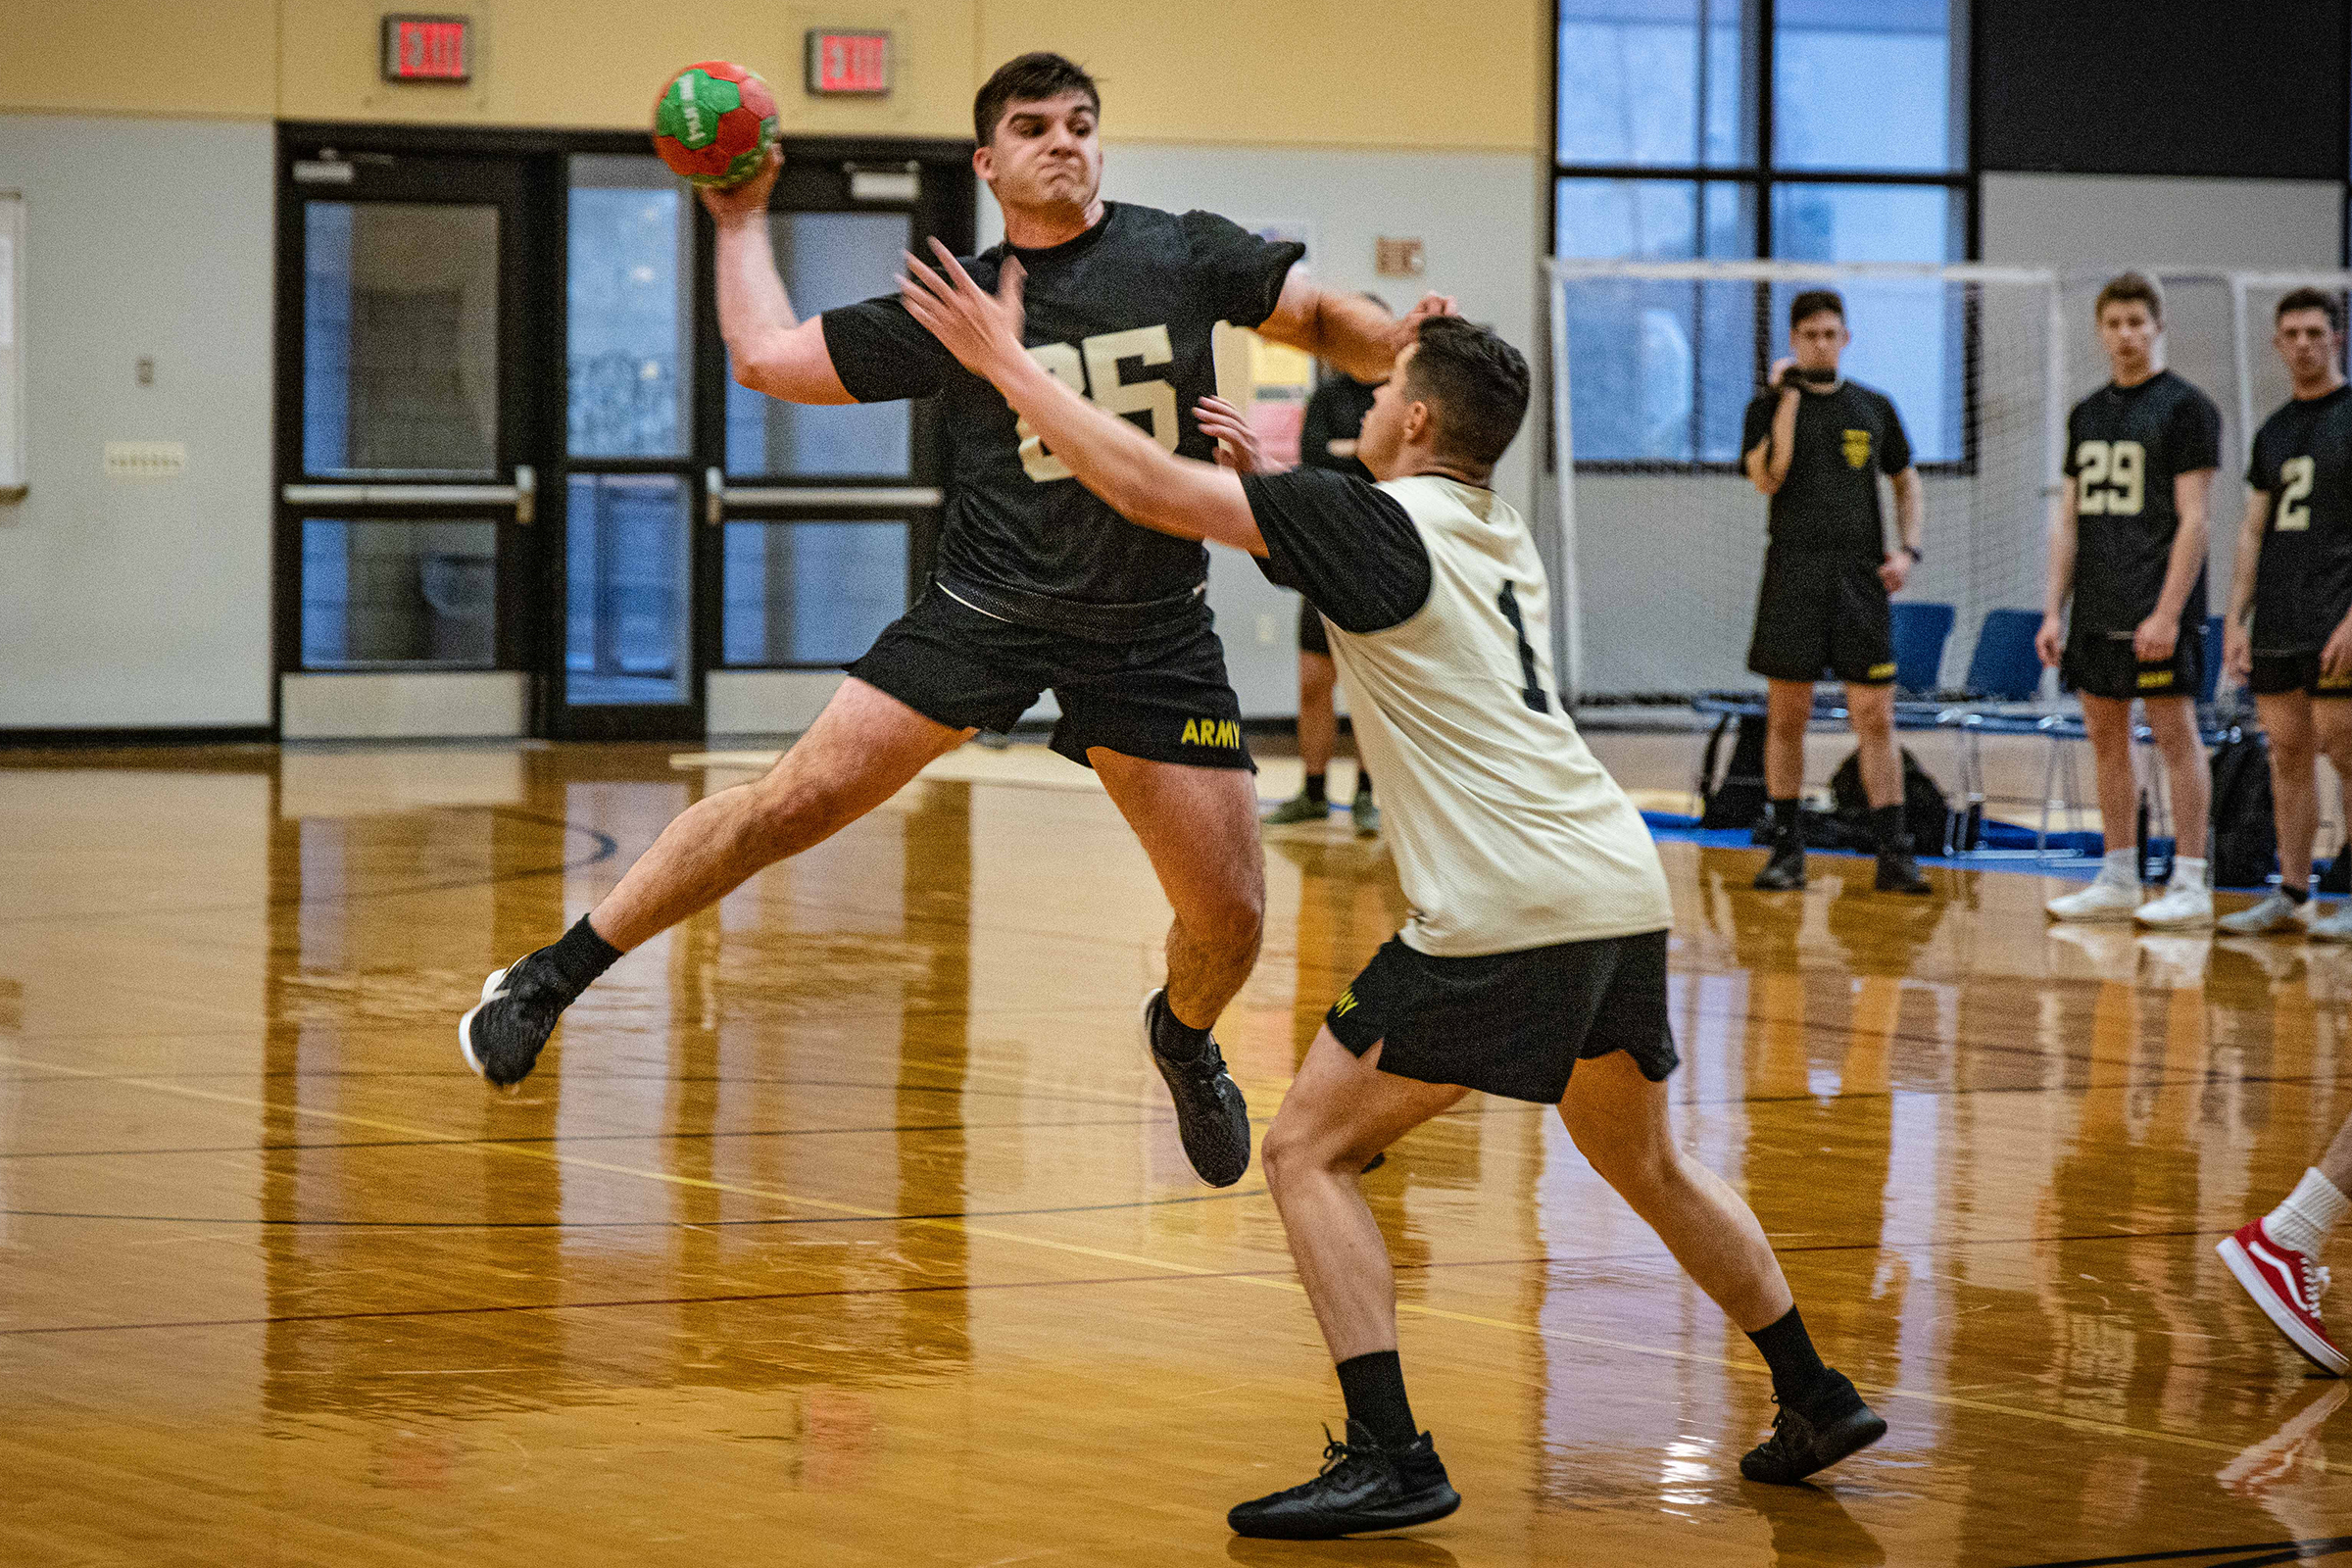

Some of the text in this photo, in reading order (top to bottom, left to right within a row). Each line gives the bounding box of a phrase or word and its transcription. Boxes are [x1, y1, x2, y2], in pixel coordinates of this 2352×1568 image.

[2075, 441, 2146, 515] 29
[2276, 456, 2315, 531] 2
[1497, 580, 1548, 713] 1
[1181, 717, 1240, 750] ARMY
